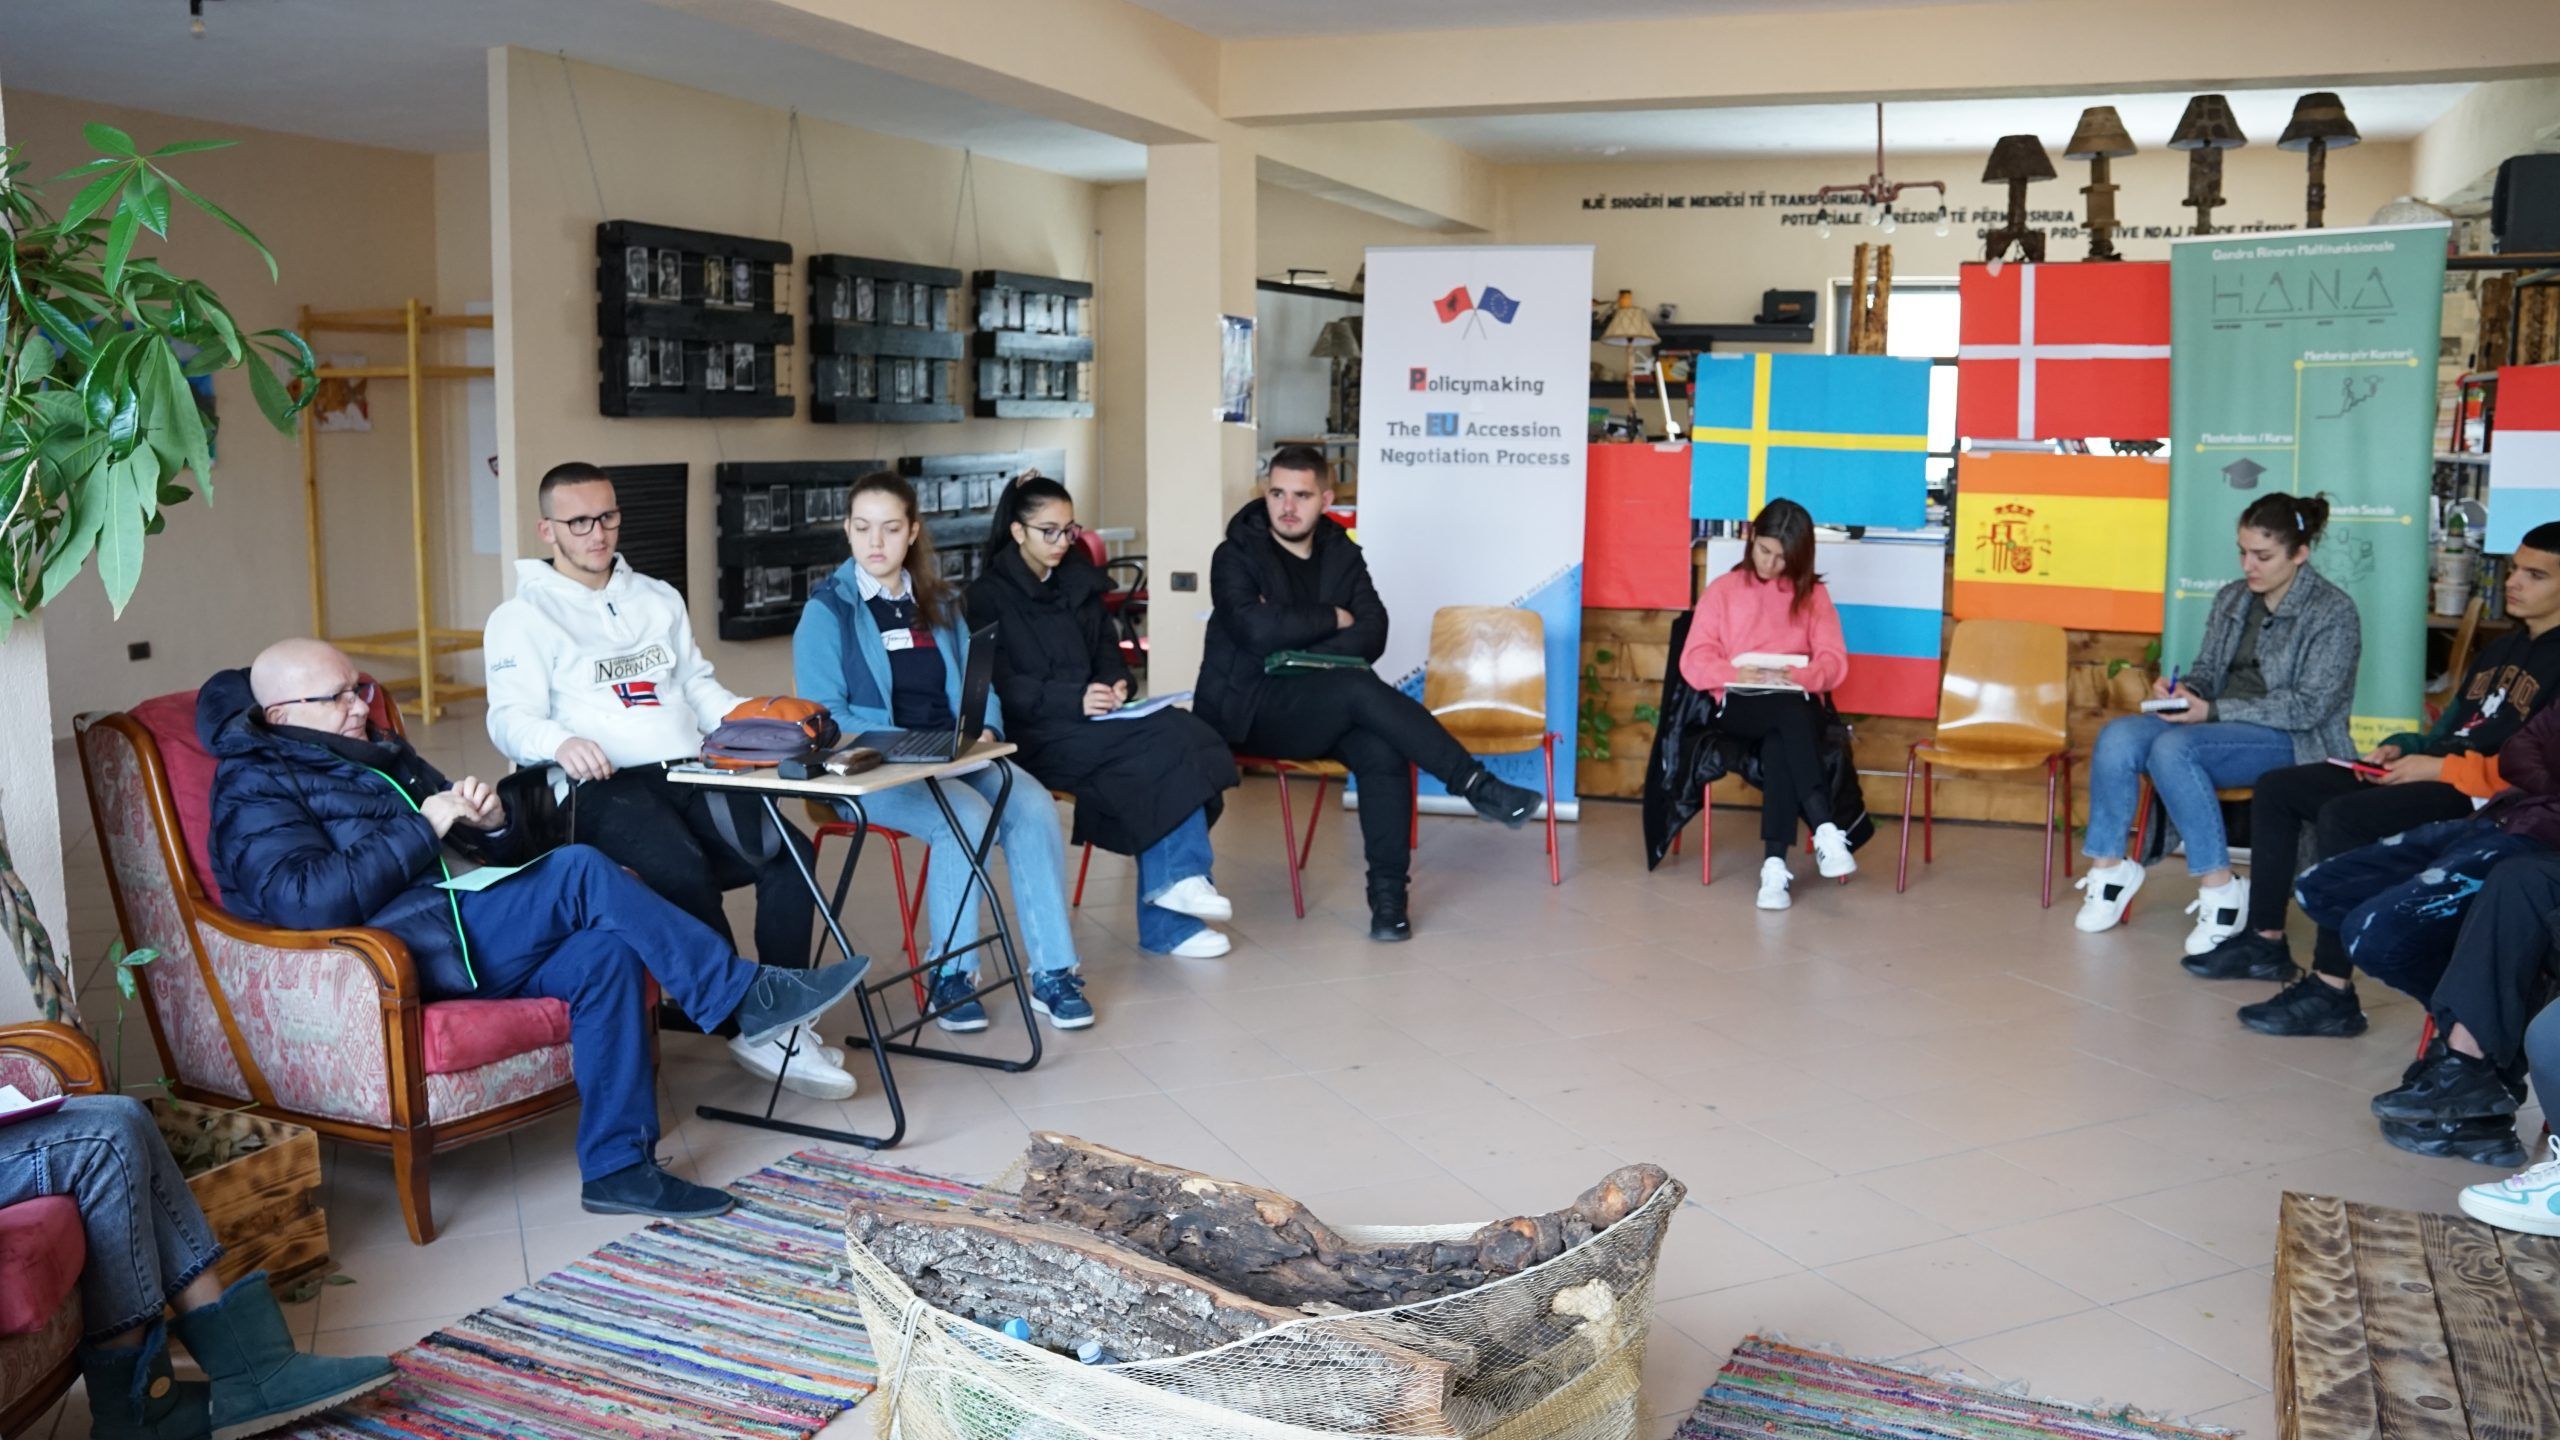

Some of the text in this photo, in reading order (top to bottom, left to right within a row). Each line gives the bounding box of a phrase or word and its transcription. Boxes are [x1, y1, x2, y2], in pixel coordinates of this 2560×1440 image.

[1409, 368, 1545, 395] Policymaking
[1387, 412, 1562, 438] The EU Accession
[1381, 449, 1571, 466] Negotiation Process
